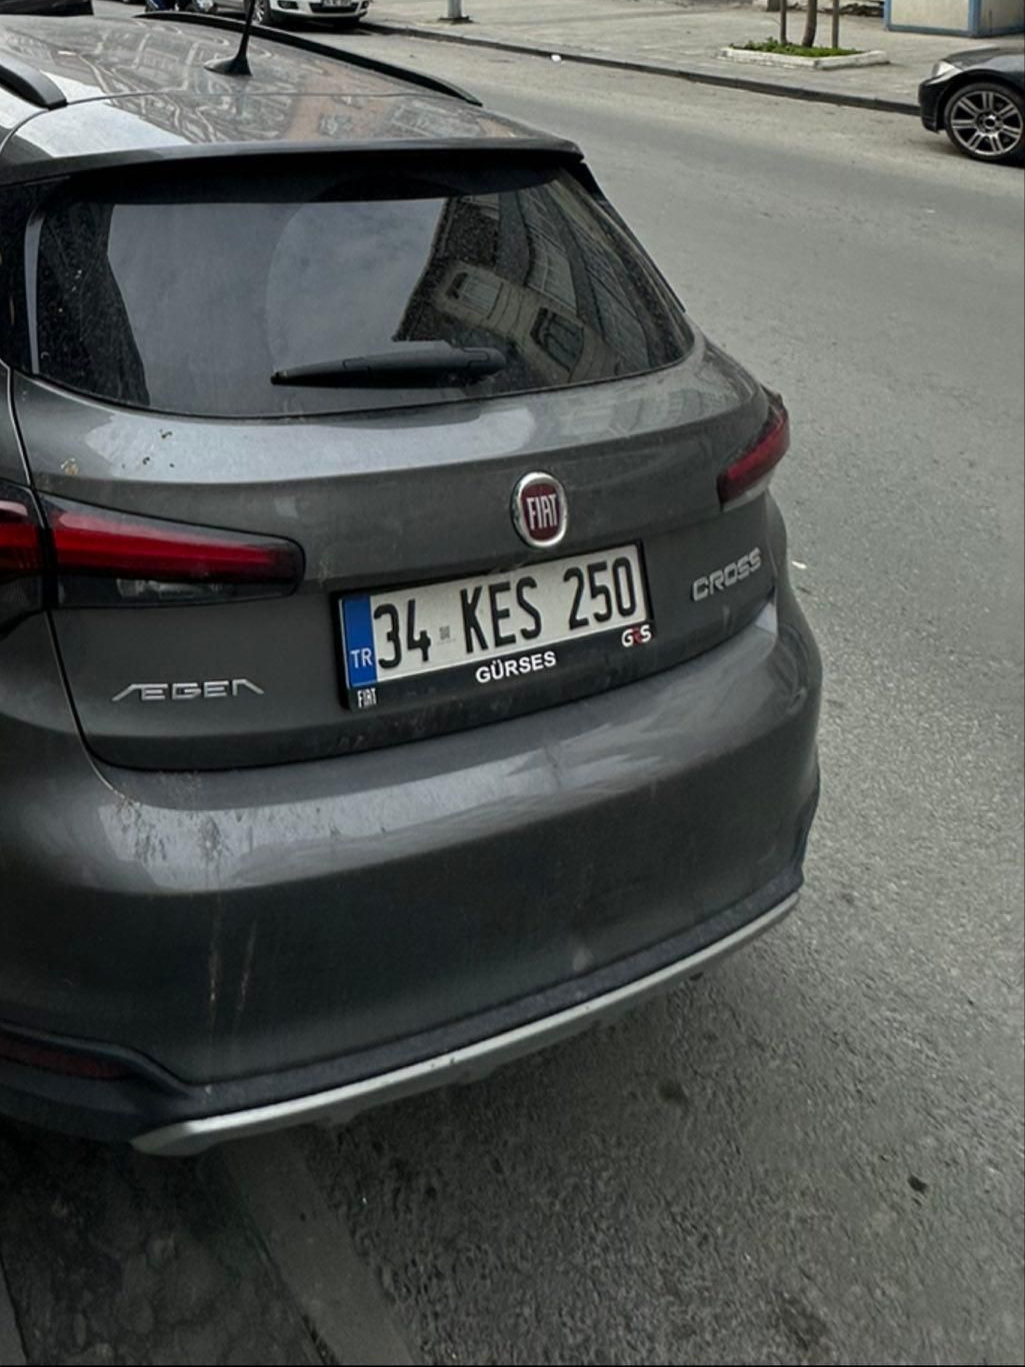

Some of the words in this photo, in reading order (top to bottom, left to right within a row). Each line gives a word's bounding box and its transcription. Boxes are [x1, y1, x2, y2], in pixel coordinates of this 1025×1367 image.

[526, 493, 559, 530] FIAT
[692, 546, 762, 602] CROSS
[373, 598, 432, 669] 34
[459, 575, 542, 654] KES
[562, 555, 638, 631] 250
[350, 648, 373, 669] TR
[475, 650, 557, 684] GÜRSES
[357, 687, 377, 709] FIAT
